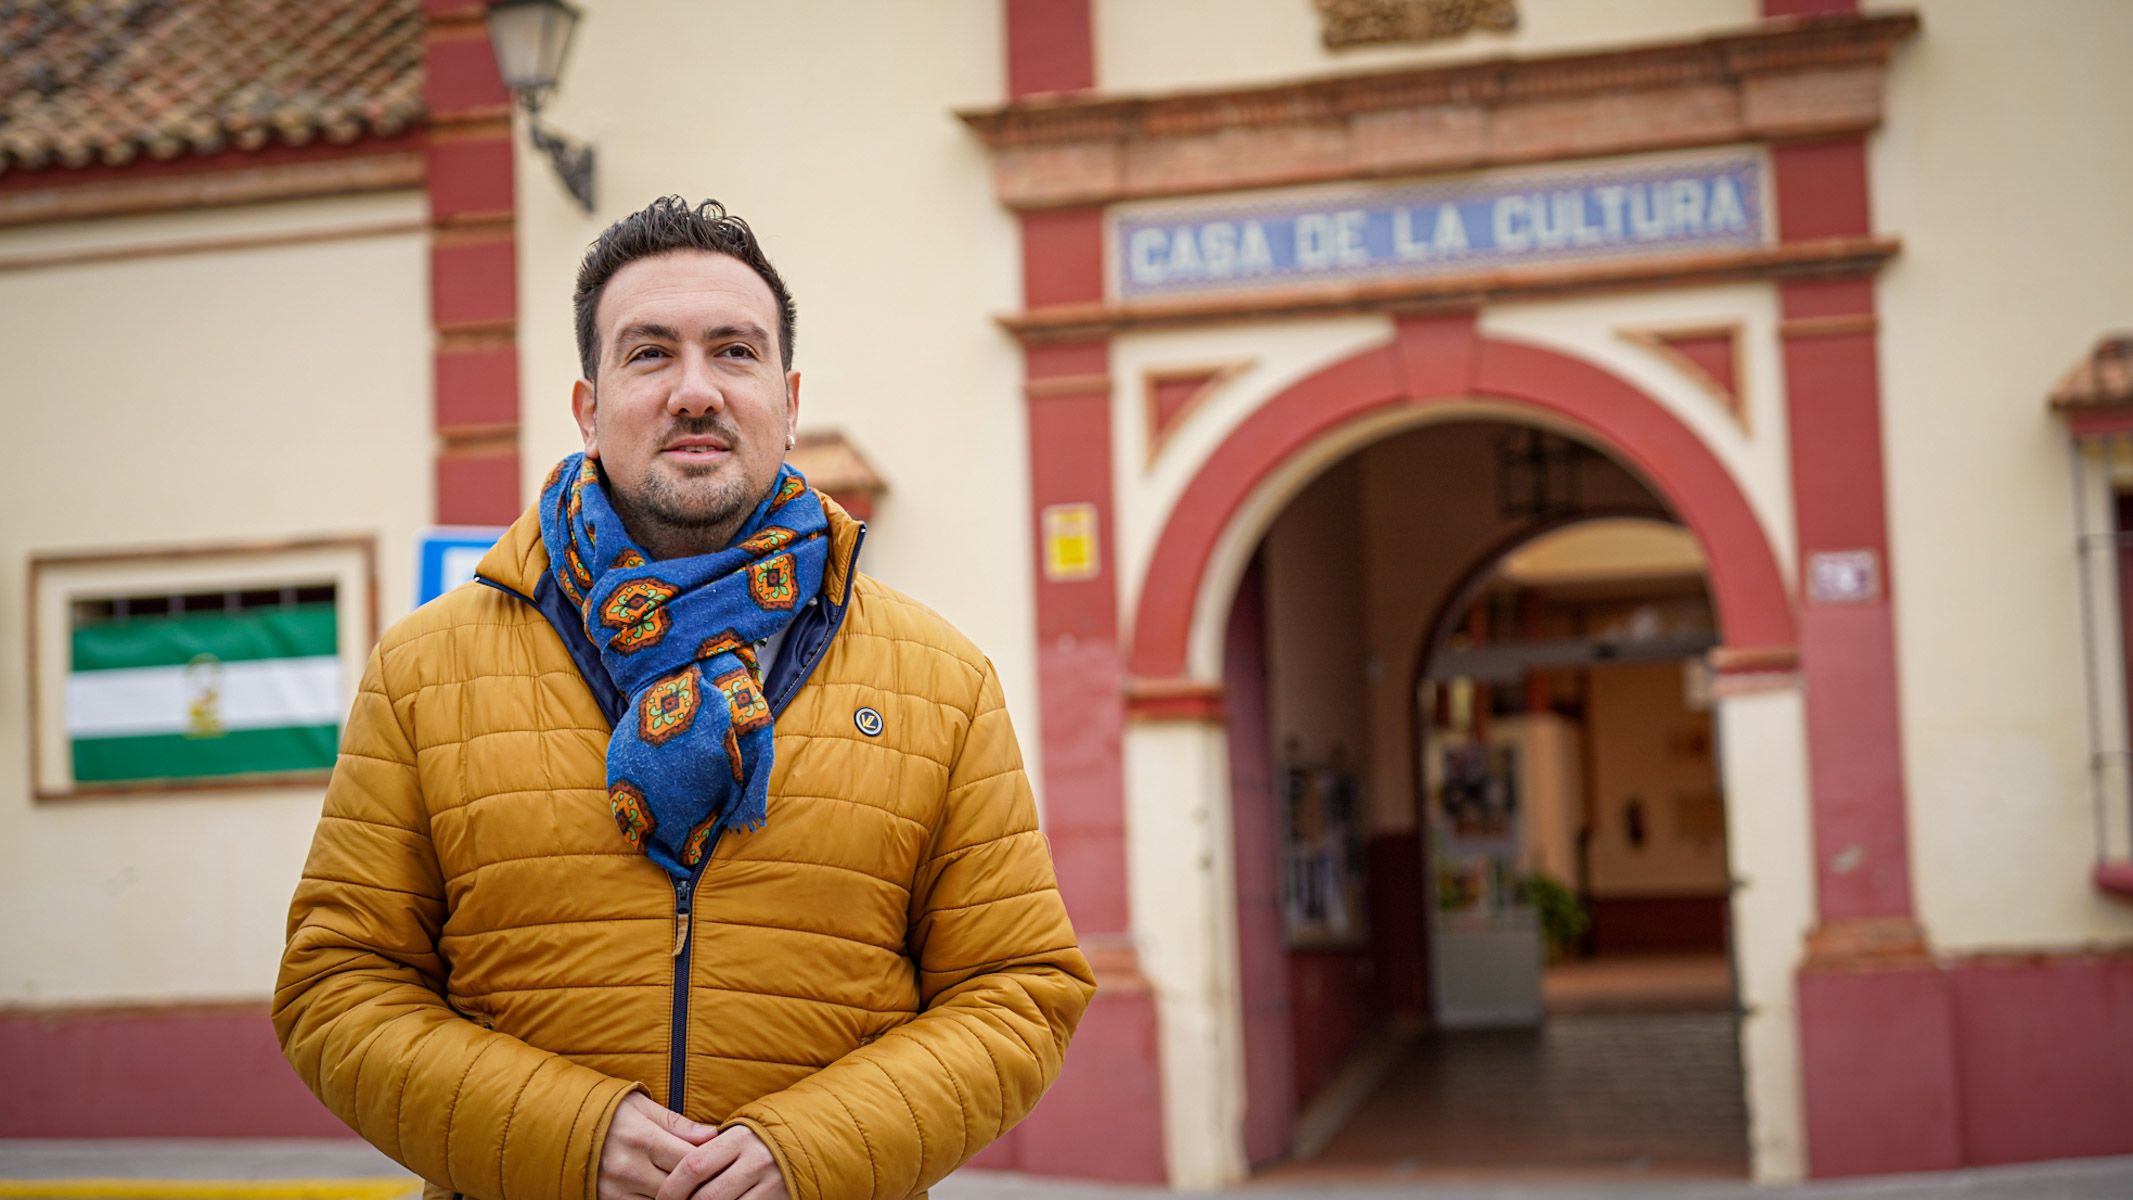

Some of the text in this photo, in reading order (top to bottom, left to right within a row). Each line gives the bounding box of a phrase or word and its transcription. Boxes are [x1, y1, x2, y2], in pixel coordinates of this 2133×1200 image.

[1130, 174, 1746, 285] CASA DE LA CULTURA
